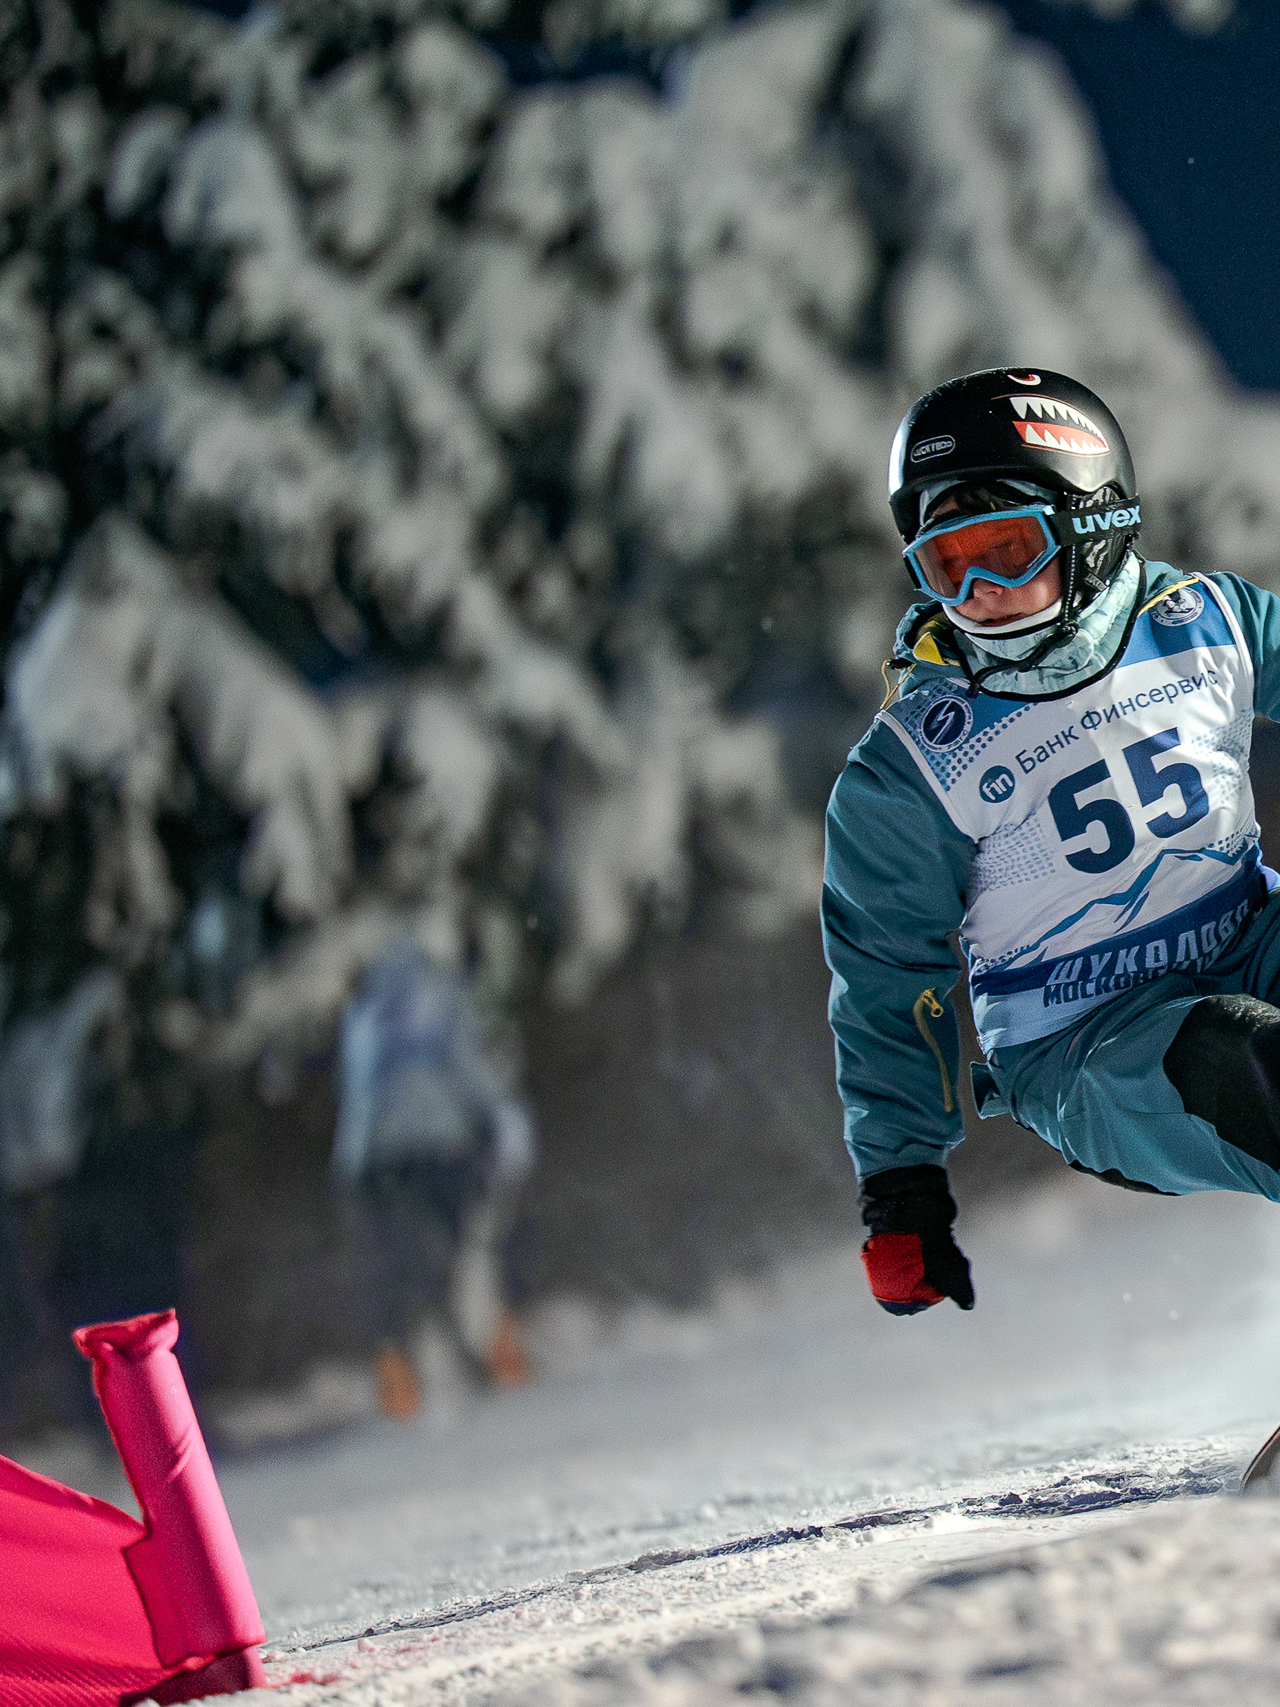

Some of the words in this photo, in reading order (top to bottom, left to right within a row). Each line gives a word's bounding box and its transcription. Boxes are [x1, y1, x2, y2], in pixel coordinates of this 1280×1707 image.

[1071, 505, 1141, 534] uvex
[1015, 725, 1080, 775] Банк
[1080, 669, 1218, 731] Финсервис
[1048, 726, 1210, 874] 55
